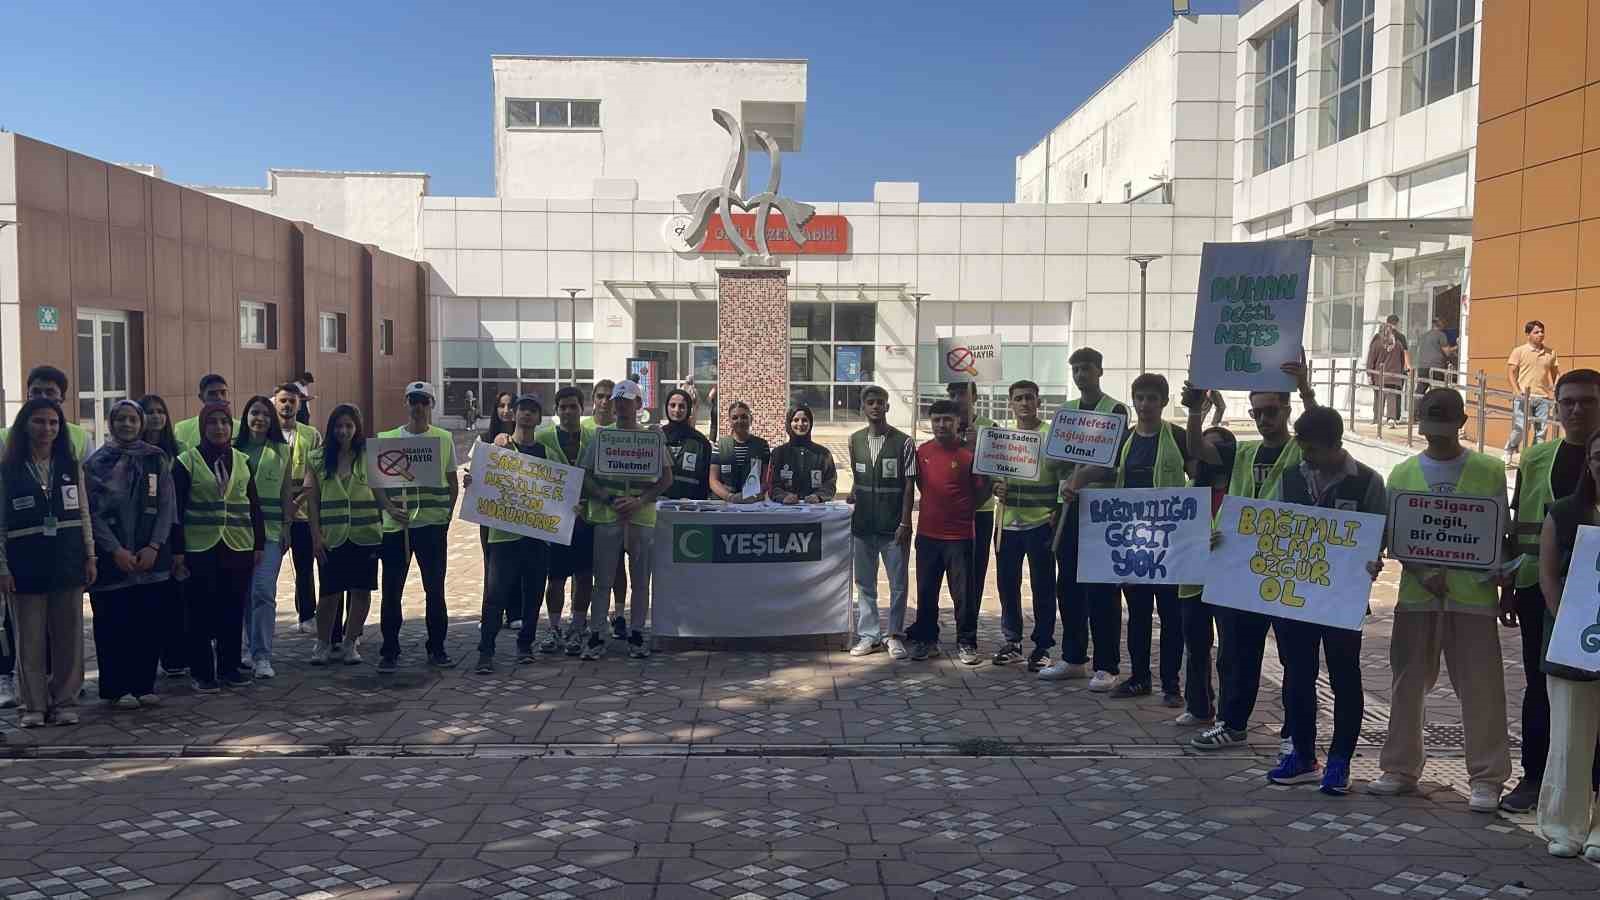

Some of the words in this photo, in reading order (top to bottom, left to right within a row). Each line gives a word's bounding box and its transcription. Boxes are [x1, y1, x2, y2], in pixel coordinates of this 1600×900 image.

[1214, 322, 1281, 347] NEFES
[1224, 344, 1263, 374] AL
[1059, 414, 1076, 426] Her
[1078, 417, 1117, 431] Nefeste
[600, 432, 633, 446] Sigara
[987, 430, 1010, 441] Sigara
[1012, 433, 1038, 444] Sadece
[606, 447, 655, 460] Geleceğini
[1064, 444, 1097, 458] Olma!
[1408, 497, 1431, 509] Bir
[1434, 499, 1486, 514] Sigara
[1238, 505, 1362, 547] BAĞIMLI
[1422, 514, 1468, 530] Değil,
[1410, 529, 1433, 541] Bir
[1435, 528, 1481, 545] Ömür
[1257, 534, 1327, 561] OLMA
[1407, 544, 1480, 561] Yakarsın.
[1111, 549, 1168, 579] YOK
[1259, 576, 1306, 608] OL
